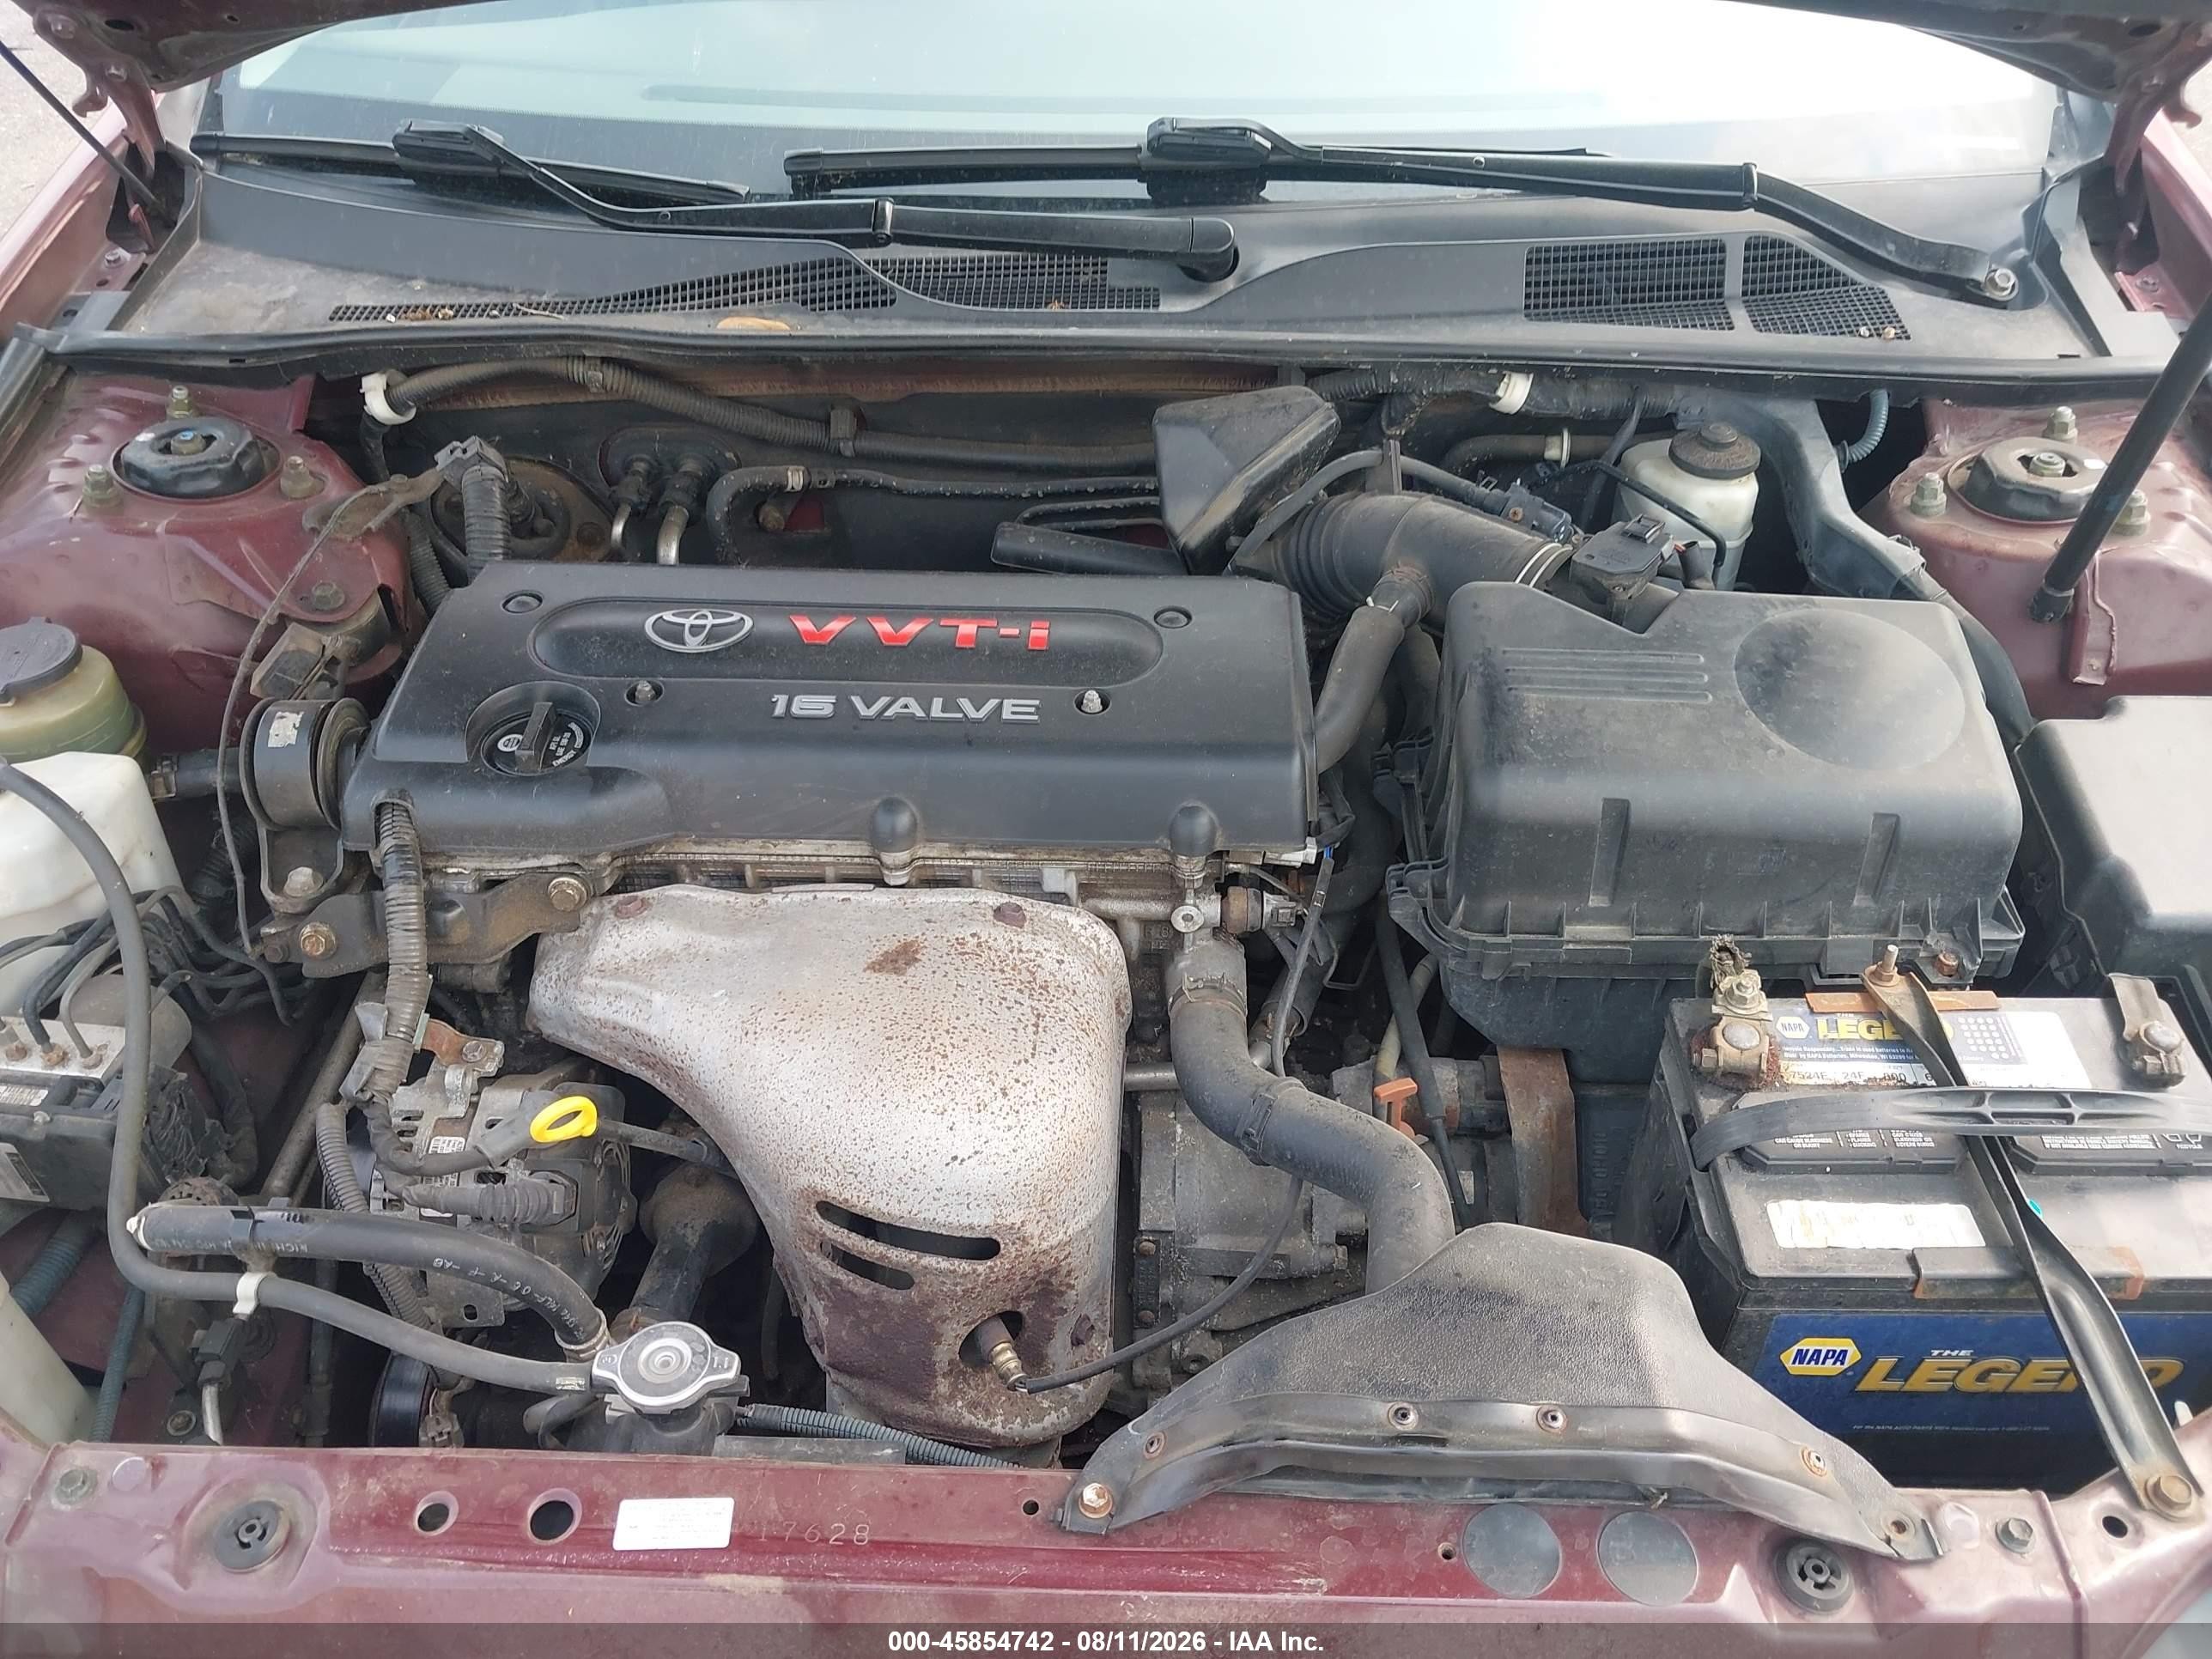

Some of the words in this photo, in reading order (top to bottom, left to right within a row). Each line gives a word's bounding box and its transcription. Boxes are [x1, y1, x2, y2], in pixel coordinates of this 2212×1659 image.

[789, 614, 1051, 651] VVT-i
[772, 694, 837, 719] 16
[850, 694, 1042, 723] VALVE
[1780, 1023, 1804, 1032] NAPA
[1791, 1348, 1848, 1366] NAPA
[1855, 1355, 2185, 1393] LEGED
